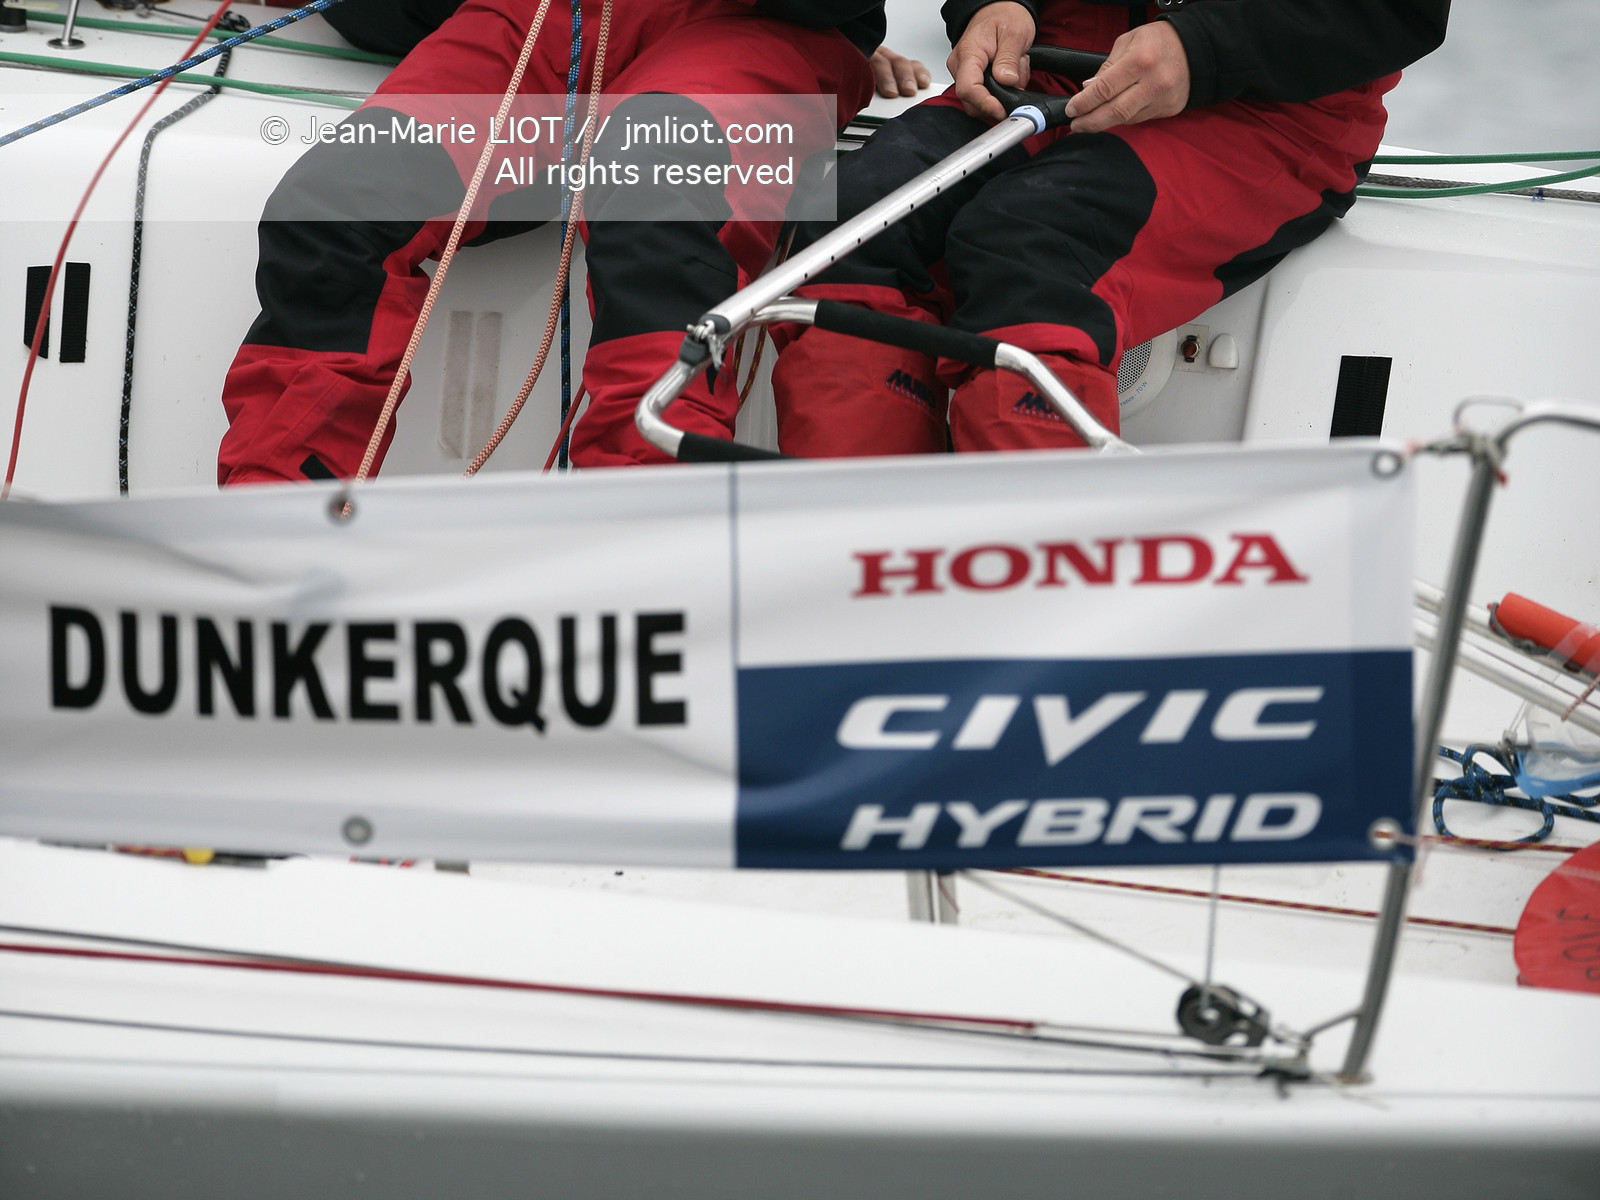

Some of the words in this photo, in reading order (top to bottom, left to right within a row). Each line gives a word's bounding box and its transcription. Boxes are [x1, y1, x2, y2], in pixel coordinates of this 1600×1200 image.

[851, 532, 1310, 598] HONDA
[49, 606, 687, 735] DUNKERQUE
[836, 686, 1325, 768] CIVIC
[840, 792, 1323, 851] HYBRID
